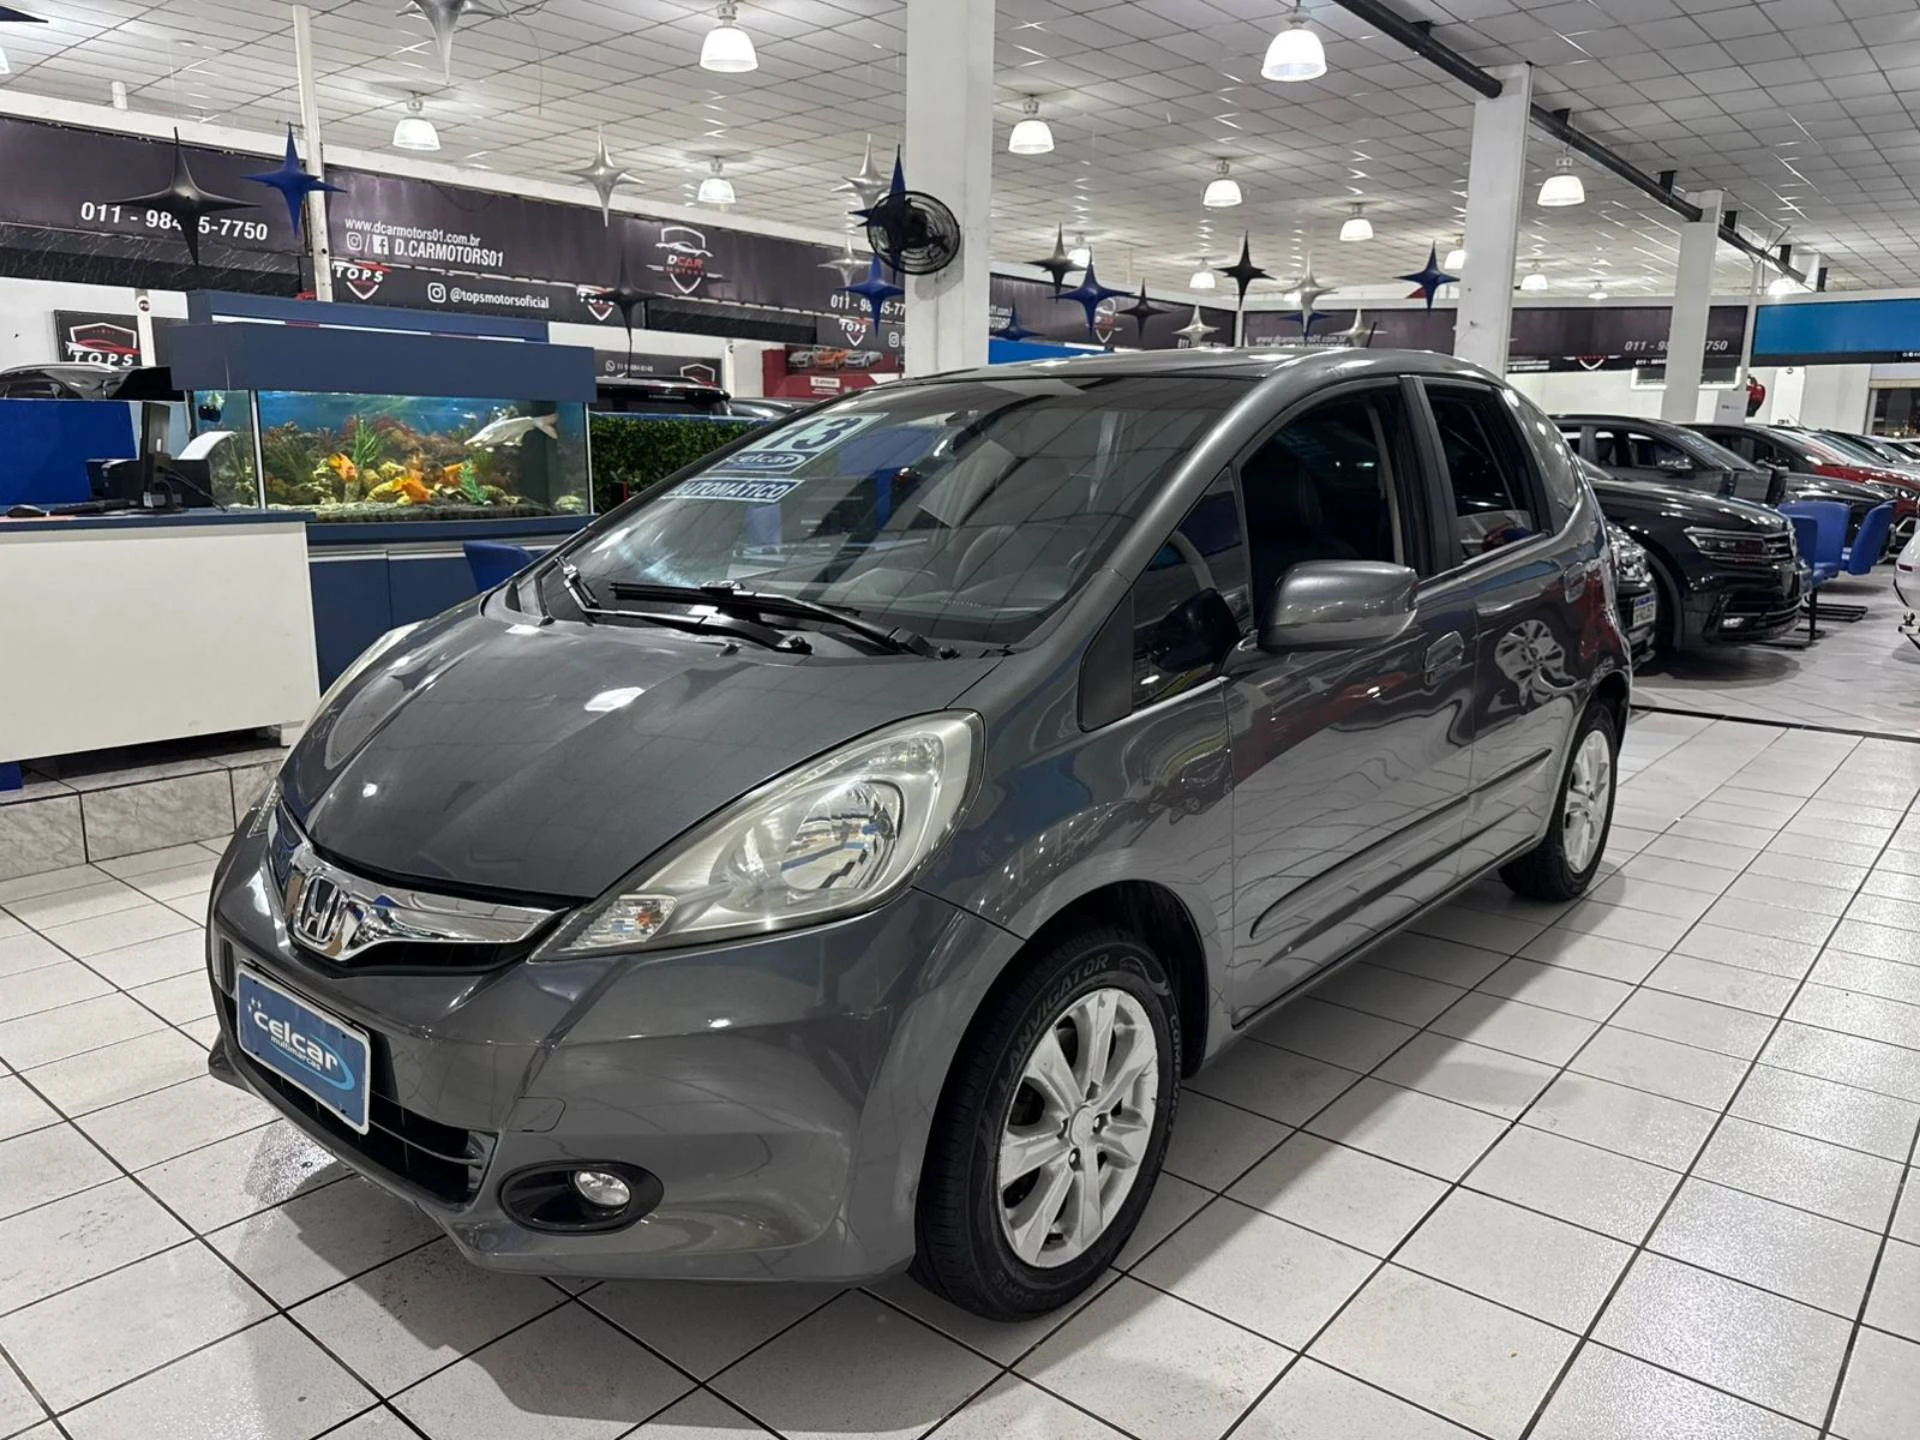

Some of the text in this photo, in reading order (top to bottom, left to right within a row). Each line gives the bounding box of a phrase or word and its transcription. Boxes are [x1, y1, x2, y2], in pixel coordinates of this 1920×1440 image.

[80, 202, 121, 224] 011
[344, 217, 481, 247] www.dcarmotors01.com.br
[394, 238, 504, 267] D.CARMOTORS01
[335, 266, 384, 283] TOPS
[450, 287, 549, 309] @topsmotorsoficial
[830, 294, 850, 310] 011
[840, 321, 867, 333] TOPS
[1624, 341, 1647, 351] 011
[72, 351, 134, 366] TOPS
[762, 416, 863, 450] 13
[254, 1010, 338, 1071] celcar
